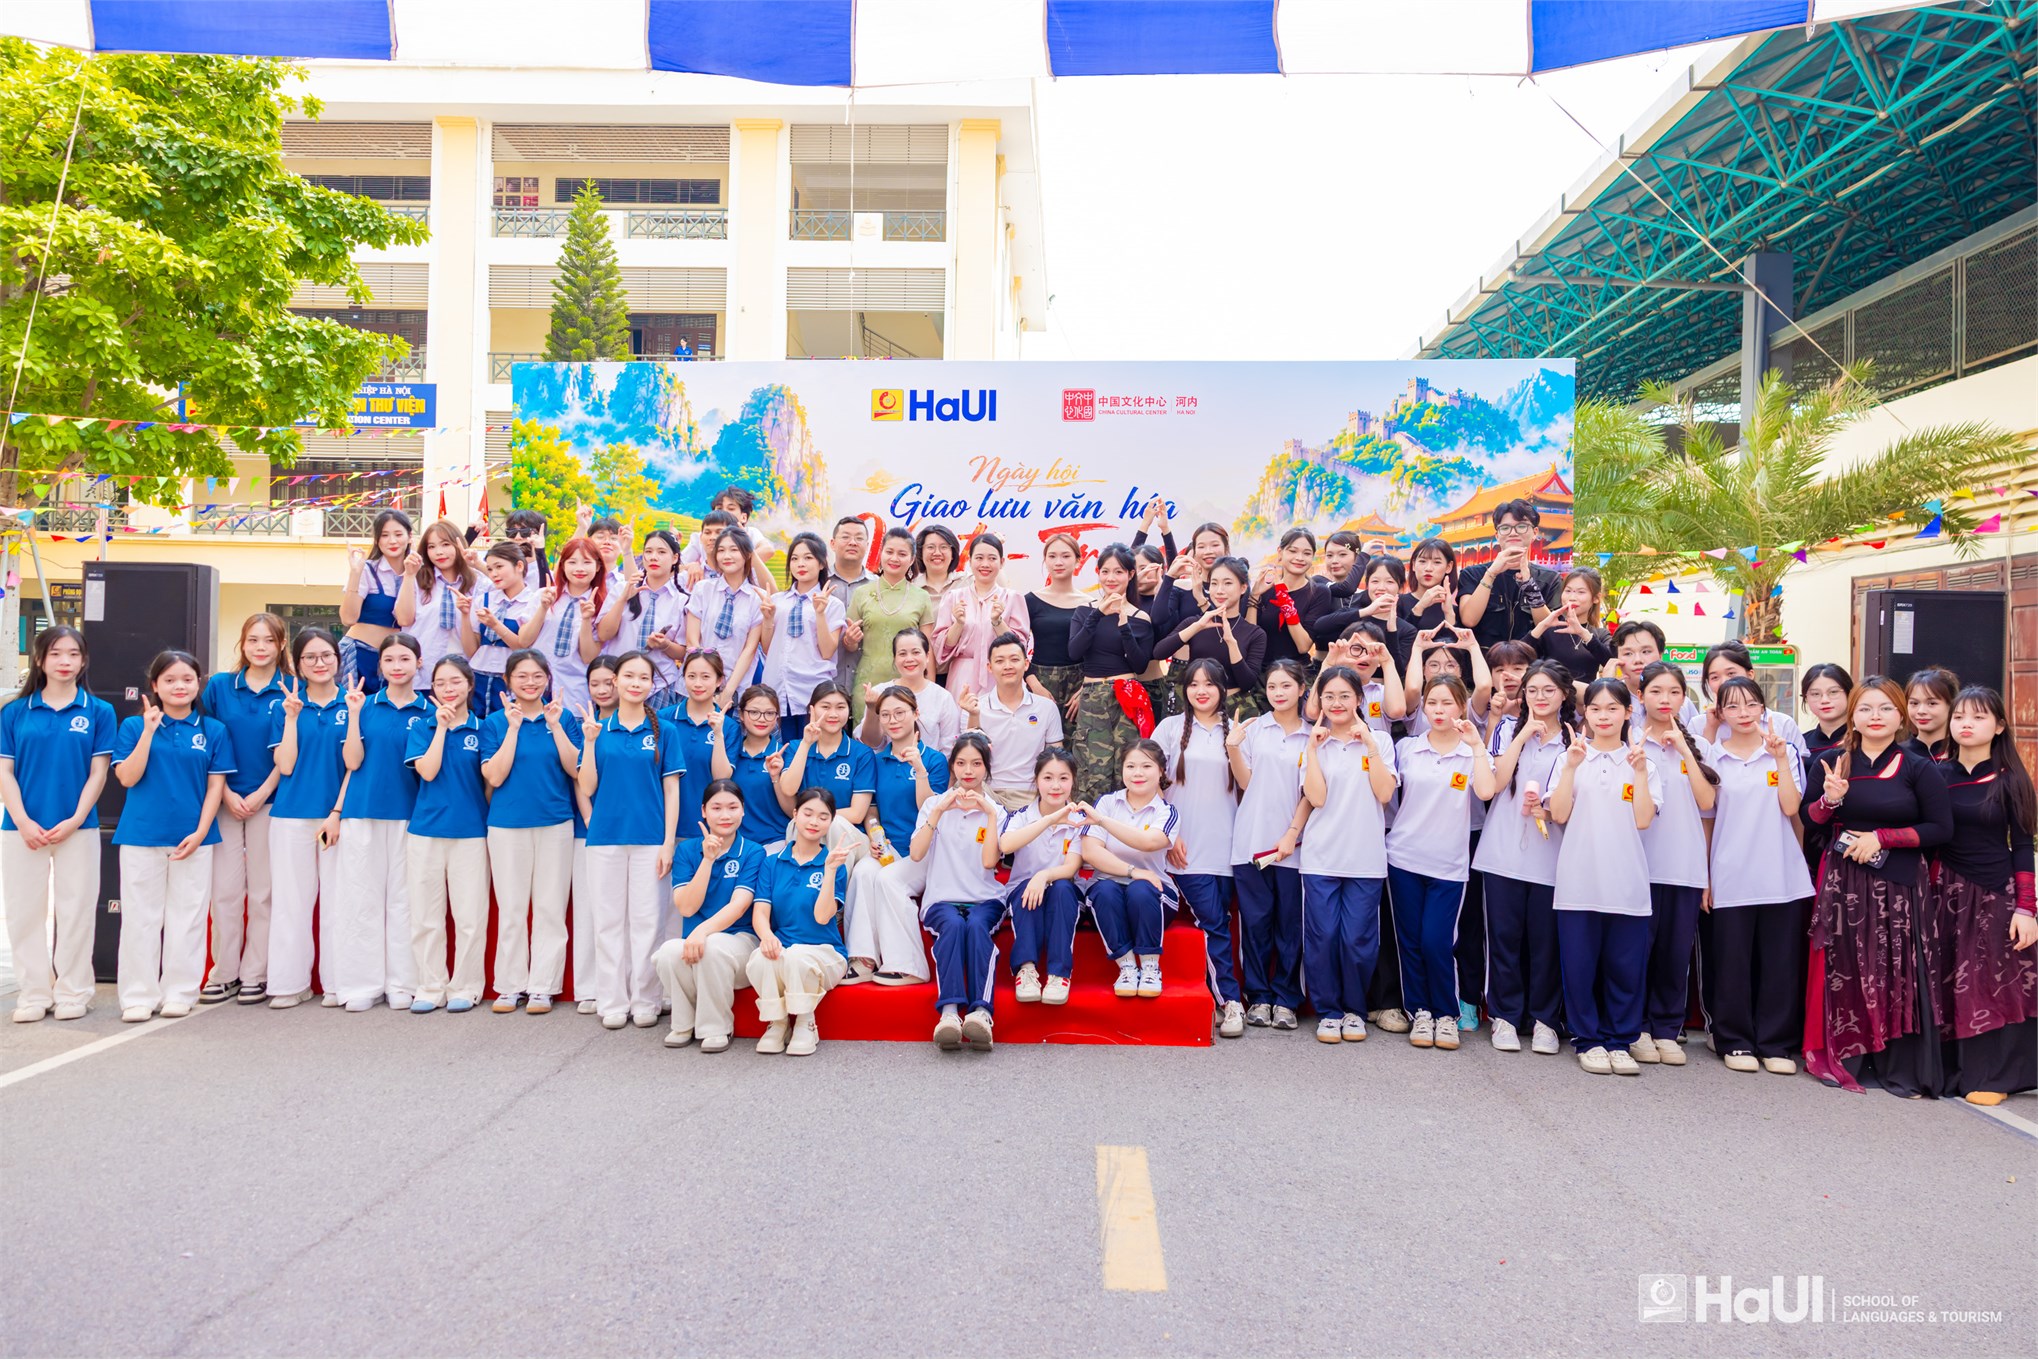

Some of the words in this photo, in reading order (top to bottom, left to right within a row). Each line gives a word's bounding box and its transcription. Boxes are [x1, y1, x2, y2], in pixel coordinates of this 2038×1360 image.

[379, 385, 393, 395] HÀ
[395, 386, 411, 396] NỘI
[368, 397, 395, 413] THƯ
[396, 395, 426, 416] VIỆN
[909, 389, 997, 422] HaUI
[1098, 395, 1167, 408] 中国文化中心
[1175, 395, 1198, 408] 河内
[373, 416, 411, 425] CENTER
[968, 455, 1042, 492] Ngày
[1045, 457, 1080, 485] hội
[889, 482, 971, 530] Giao
[977, 487, 1032, 520] lưu
[1043, 492, 1106, 520] văn
[1669, 648, 1697, 661] Food
